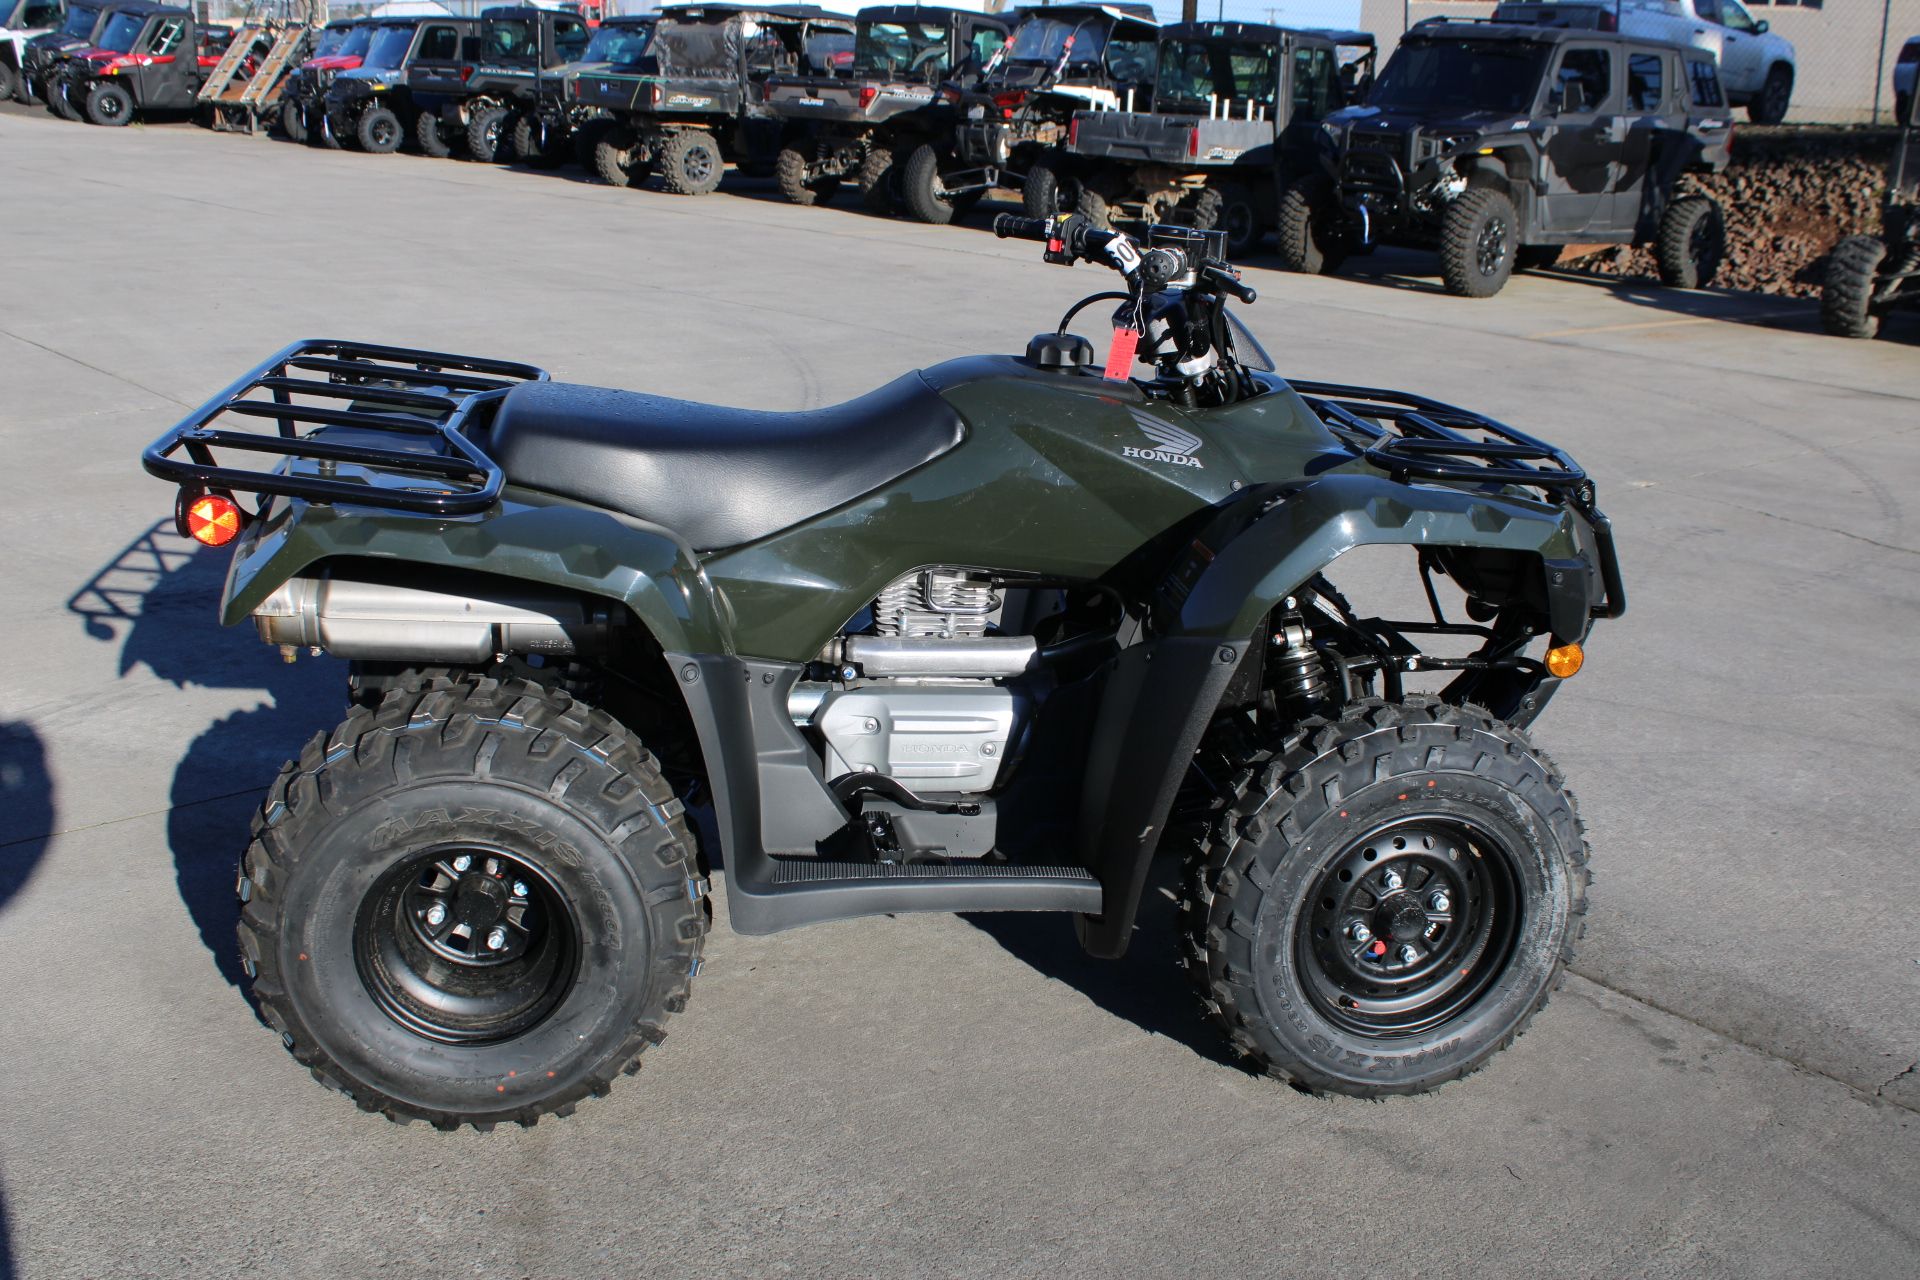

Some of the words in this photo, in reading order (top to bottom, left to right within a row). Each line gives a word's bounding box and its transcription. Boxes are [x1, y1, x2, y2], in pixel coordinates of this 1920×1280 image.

[1122, 446, 1204, 469] HONDA
[902, 743, 969, 754] HONDA
[371, 807, 586, 868] MAXXIS
[1307, 1033, 1463, 1073] MAXXIS
